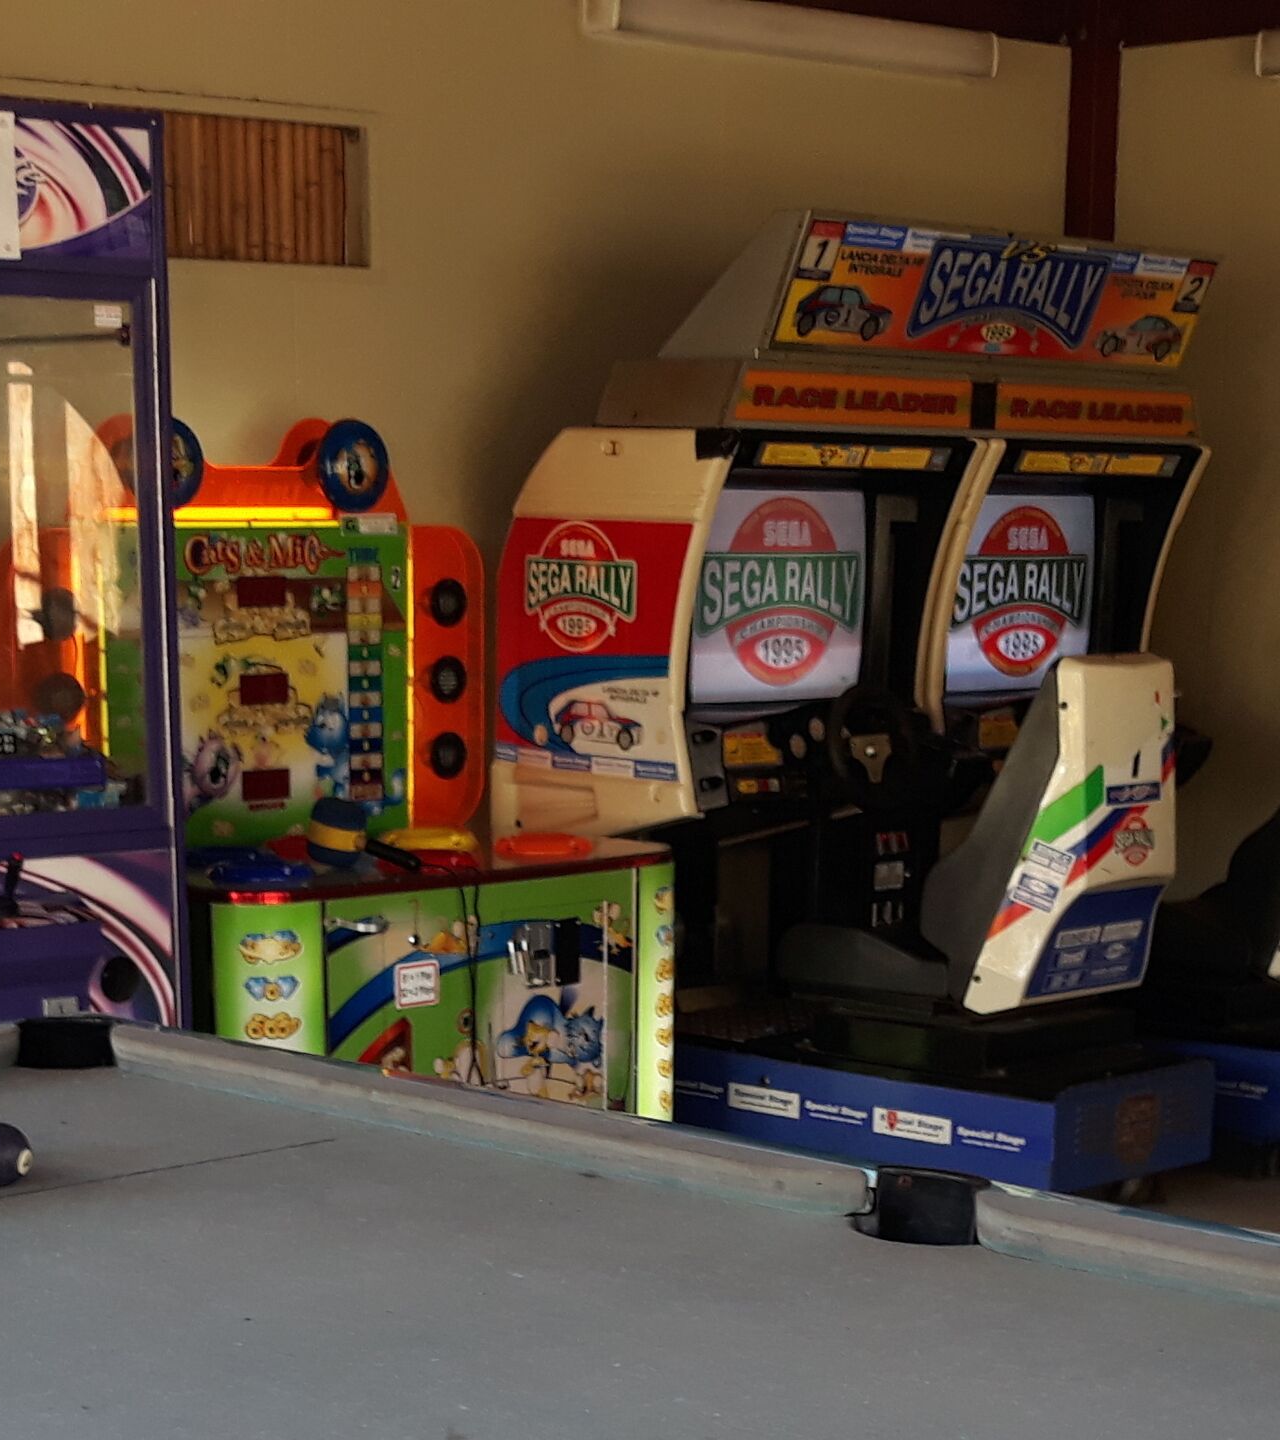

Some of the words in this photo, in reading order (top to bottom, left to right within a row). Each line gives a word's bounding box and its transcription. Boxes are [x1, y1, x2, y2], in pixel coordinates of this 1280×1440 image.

[814, 240, 828, 267] 1
[920, 247, 1007, 325] SEGA
[1009, 260, 1104, 336] RALLY
[1182, 276, 1203, 305] 2
[752, 385, 837, 409] RACE
[844, 389, 958, 415] LEADER
[1010, 396, 1081, 420] RACE
[1088, 400, 1183, 424] LEADER
[764, 521, 812, 547] SEGA
[1007, 527, 1048, 550] SEGA
[528, 561, 573, 605] SEGA
[575, 565, 632, 612] RALLY
[703, 560, 778, 626] SEGA
[785, 561, 856, 621] RALLY
[954, 562, 1018, 622] SEGA
[1024, 562, 1084, 617] RALLY
[562, 617, 592, 634] 1995
[762, 637, 804, 664] 1995
[1005, 632, 1038, 658] 1995
